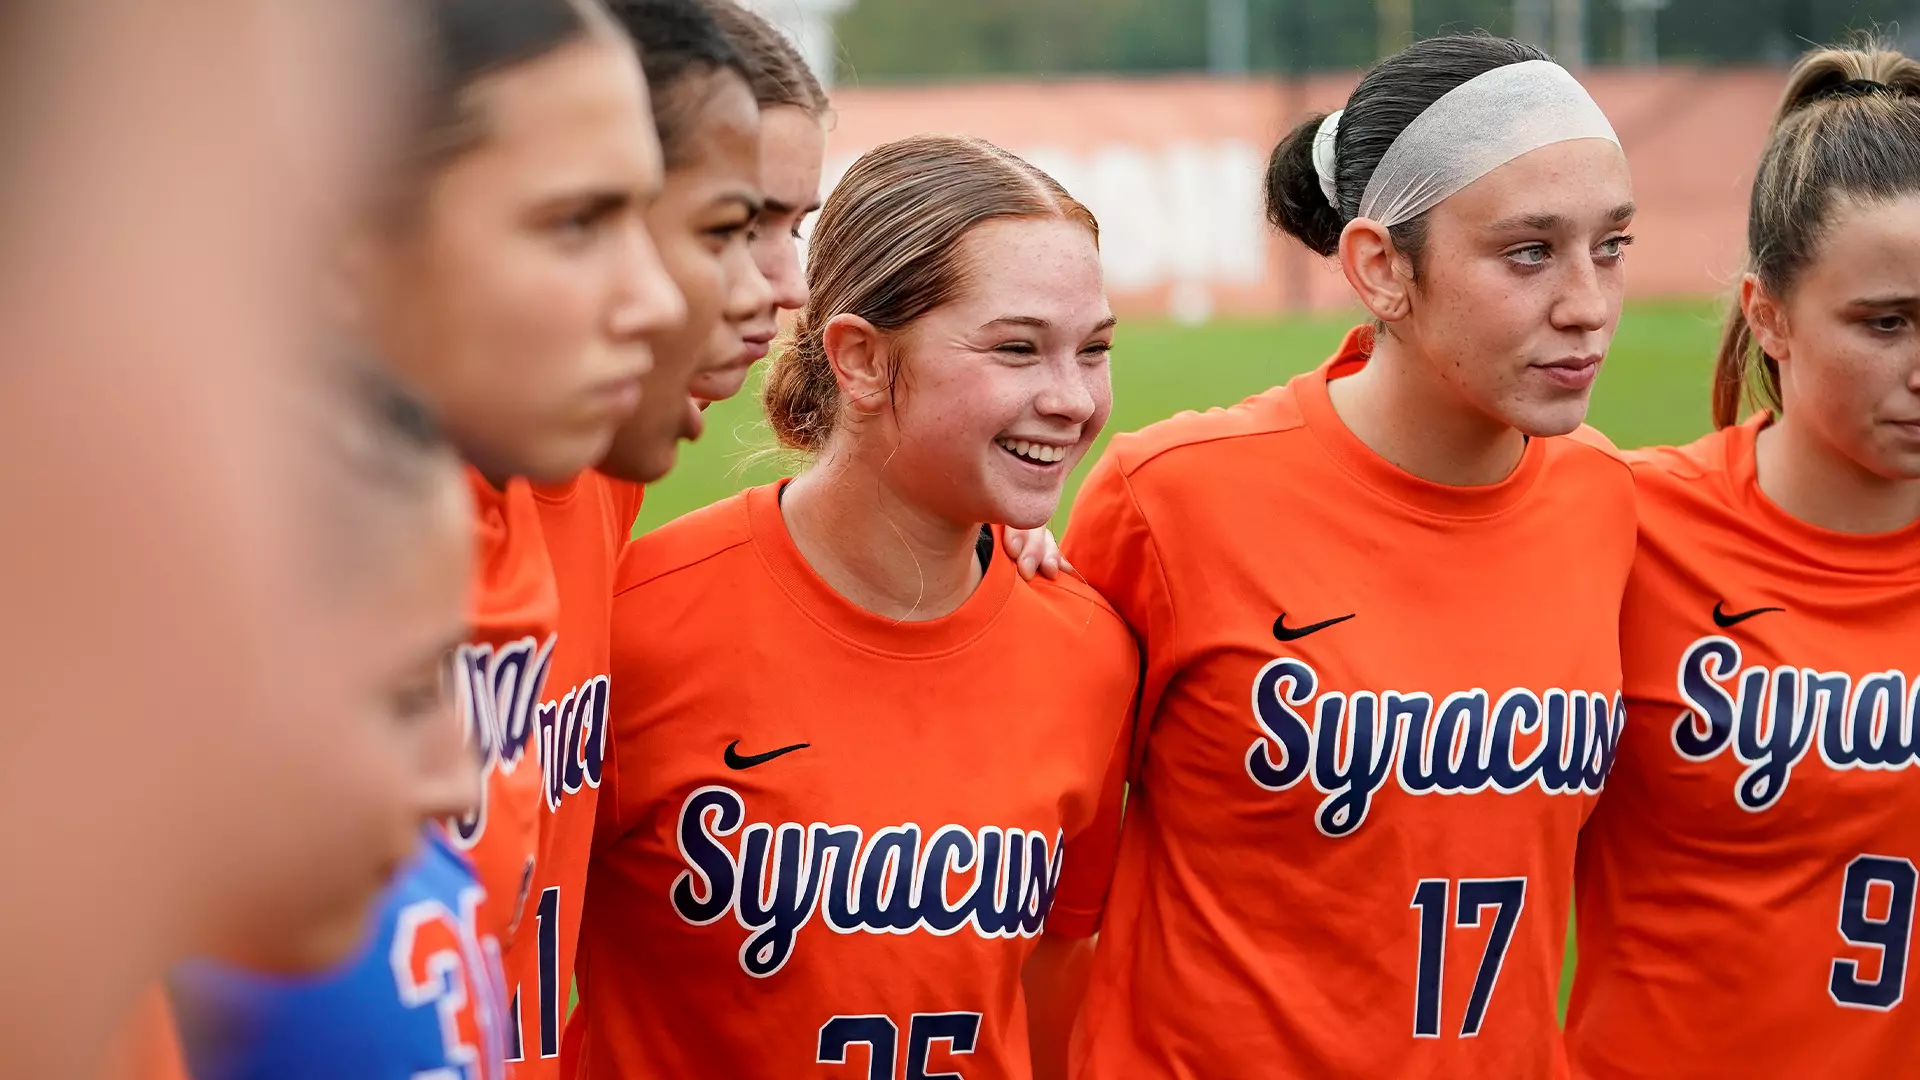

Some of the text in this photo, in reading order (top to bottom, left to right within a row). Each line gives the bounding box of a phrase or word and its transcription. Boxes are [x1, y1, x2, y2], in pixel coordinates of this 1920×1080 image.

[1671, 635, 1920, 814] Syra
[670, 785, 1064, 979] Syracus
[1409, 876, 1528, 1039] 17
[1828, 853, 1919, 1012] 9
